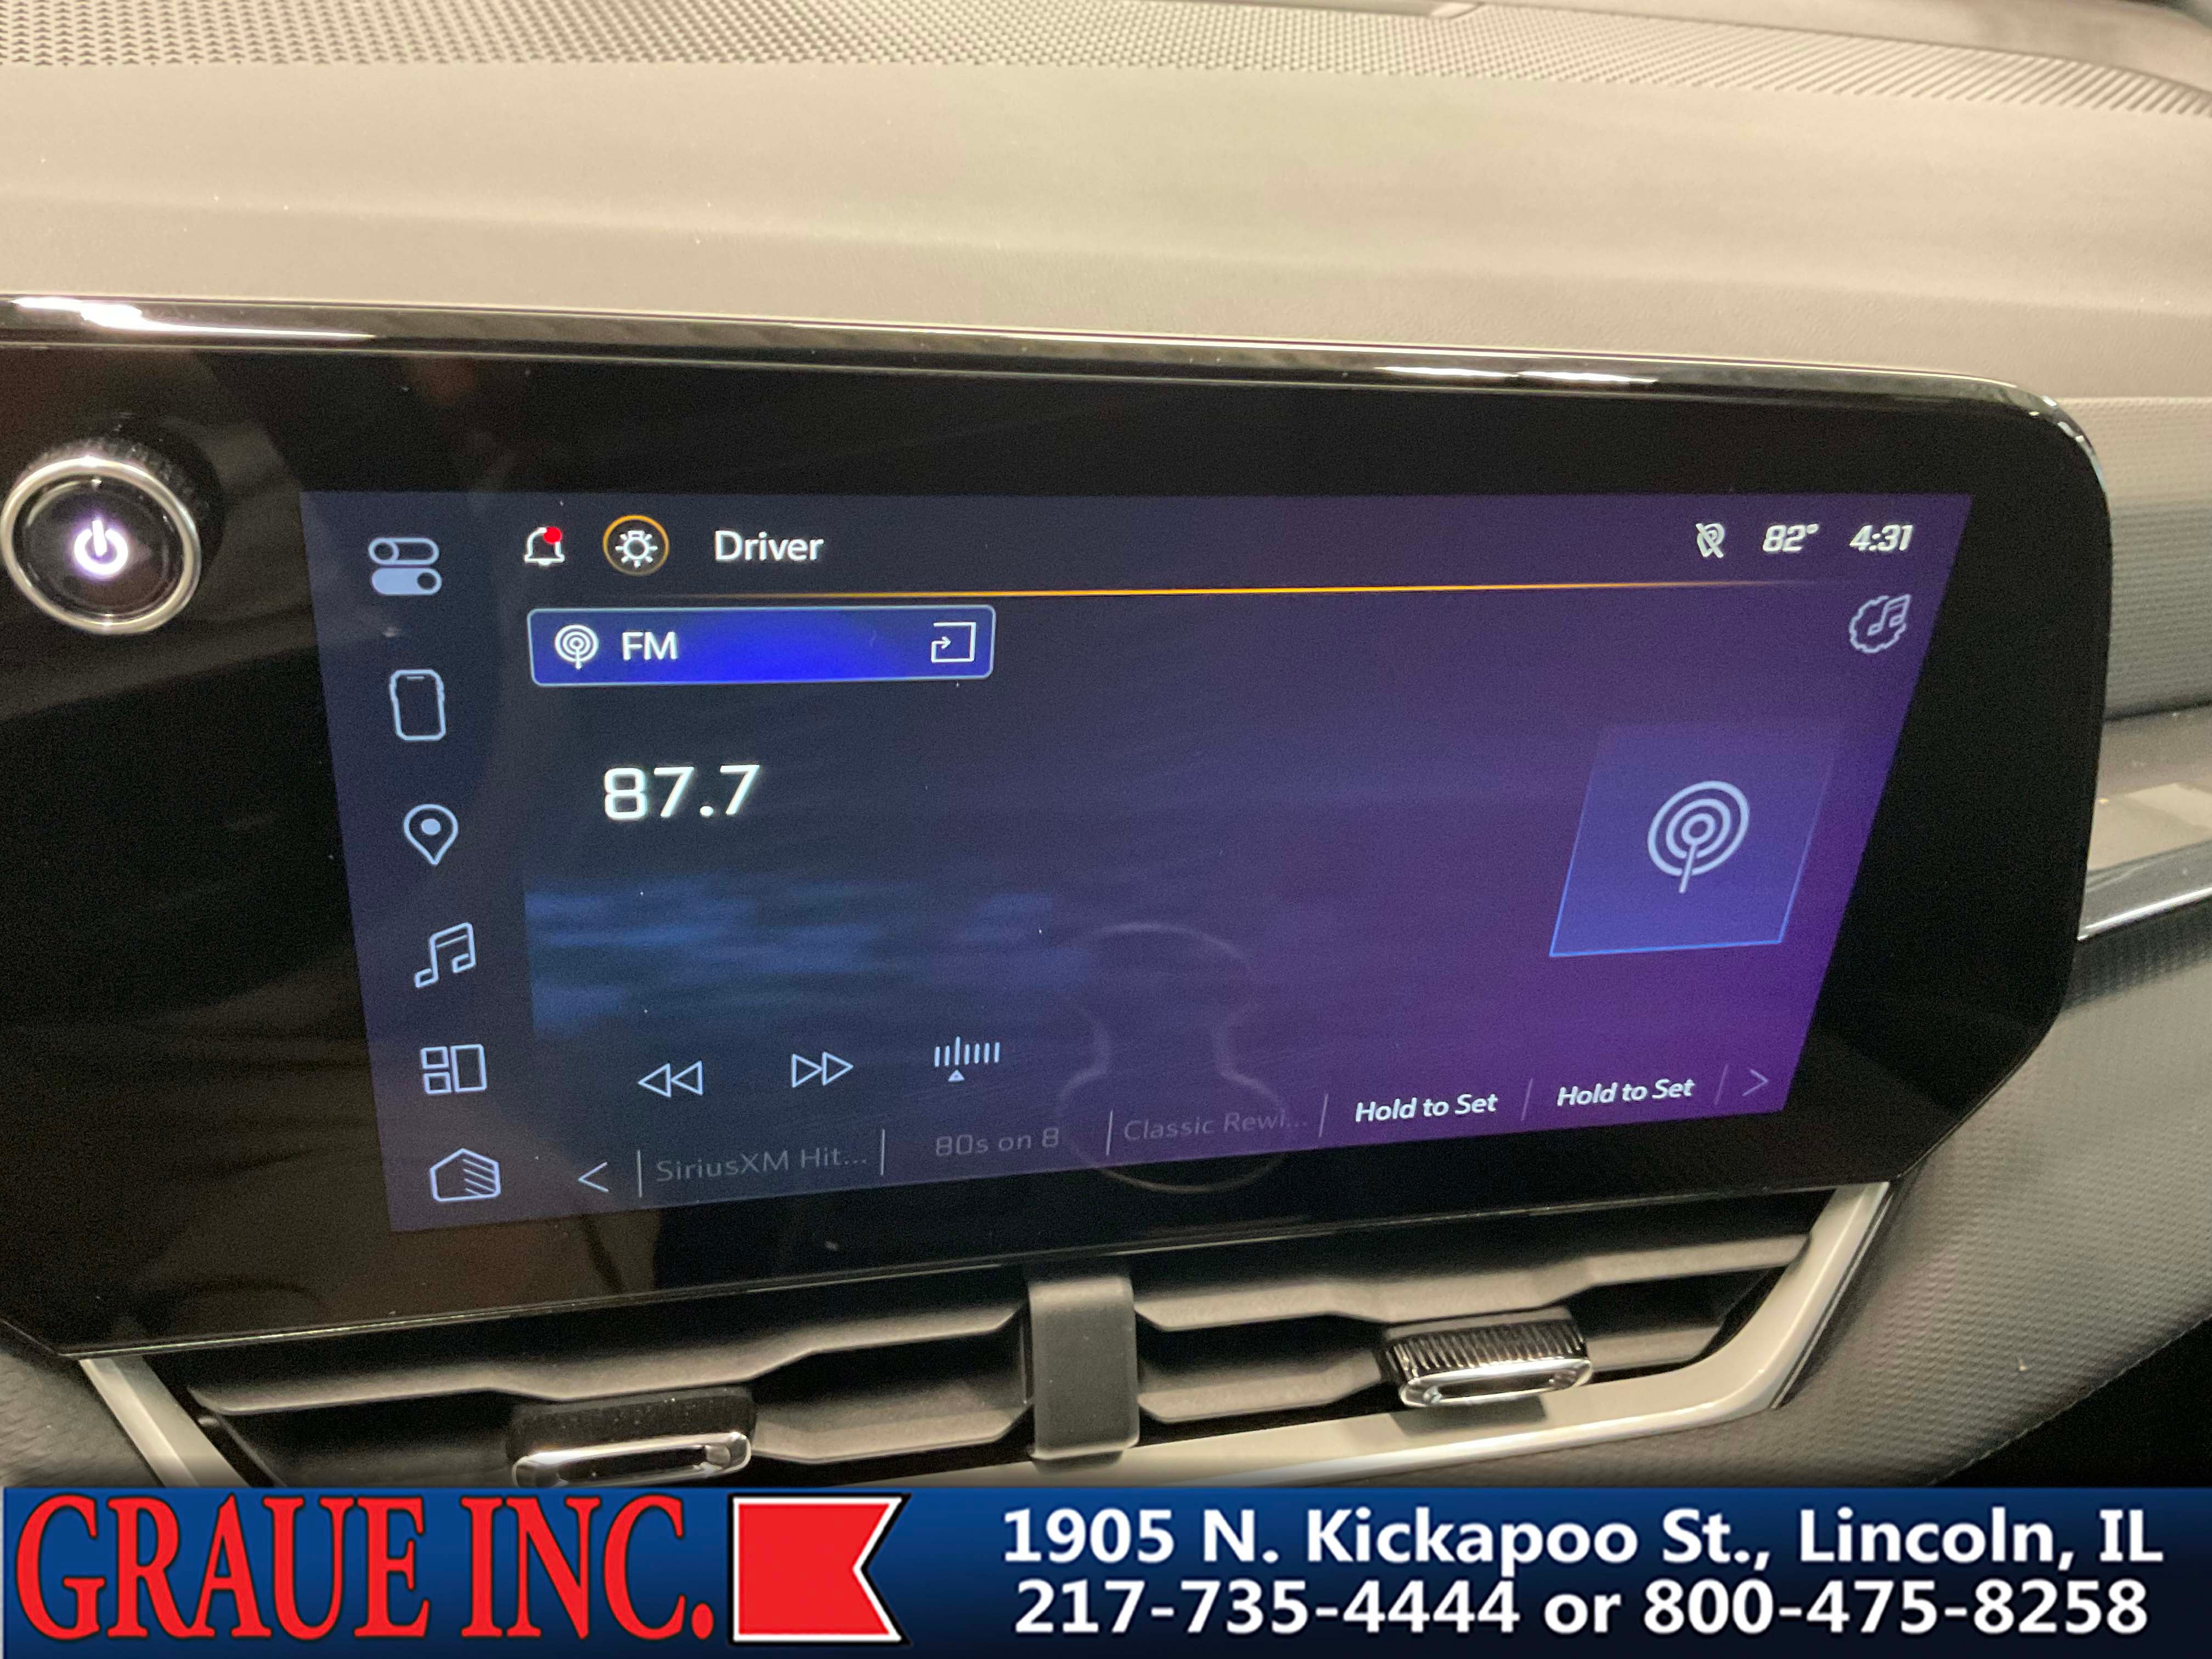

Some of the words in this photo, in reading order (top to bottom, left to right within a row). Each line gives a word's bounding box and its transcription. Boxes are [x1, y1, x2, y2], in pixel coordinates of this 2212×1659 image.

[714, 529, 825, 562] Driver
[1762, 523, 1820, 554] 82°
[1849, 523, 1914, 552] 4:31
[621, 630, 679, 662] FM
[603, 763, 761, 822] 87.7
[1556, 1081, 1618, 1107] Hold
[1621, 1083, 1648, 1102] to
[1651, 1078, 1695, 1099] Set
[1355, 1097, 1418, 1123] Hold
[1422, 1098, 1449, 1118] to
[1454, 1093, 1499, 1115] Set
[935, 1135, 989, 1157] 80s
[998, 1131, 1033, 1152] on
[1041, 1127, 1060, 1148] 8
[1124, 1116, 1215, 1142] Classic
[656, 1149, 789, 1182] SiriusXM
